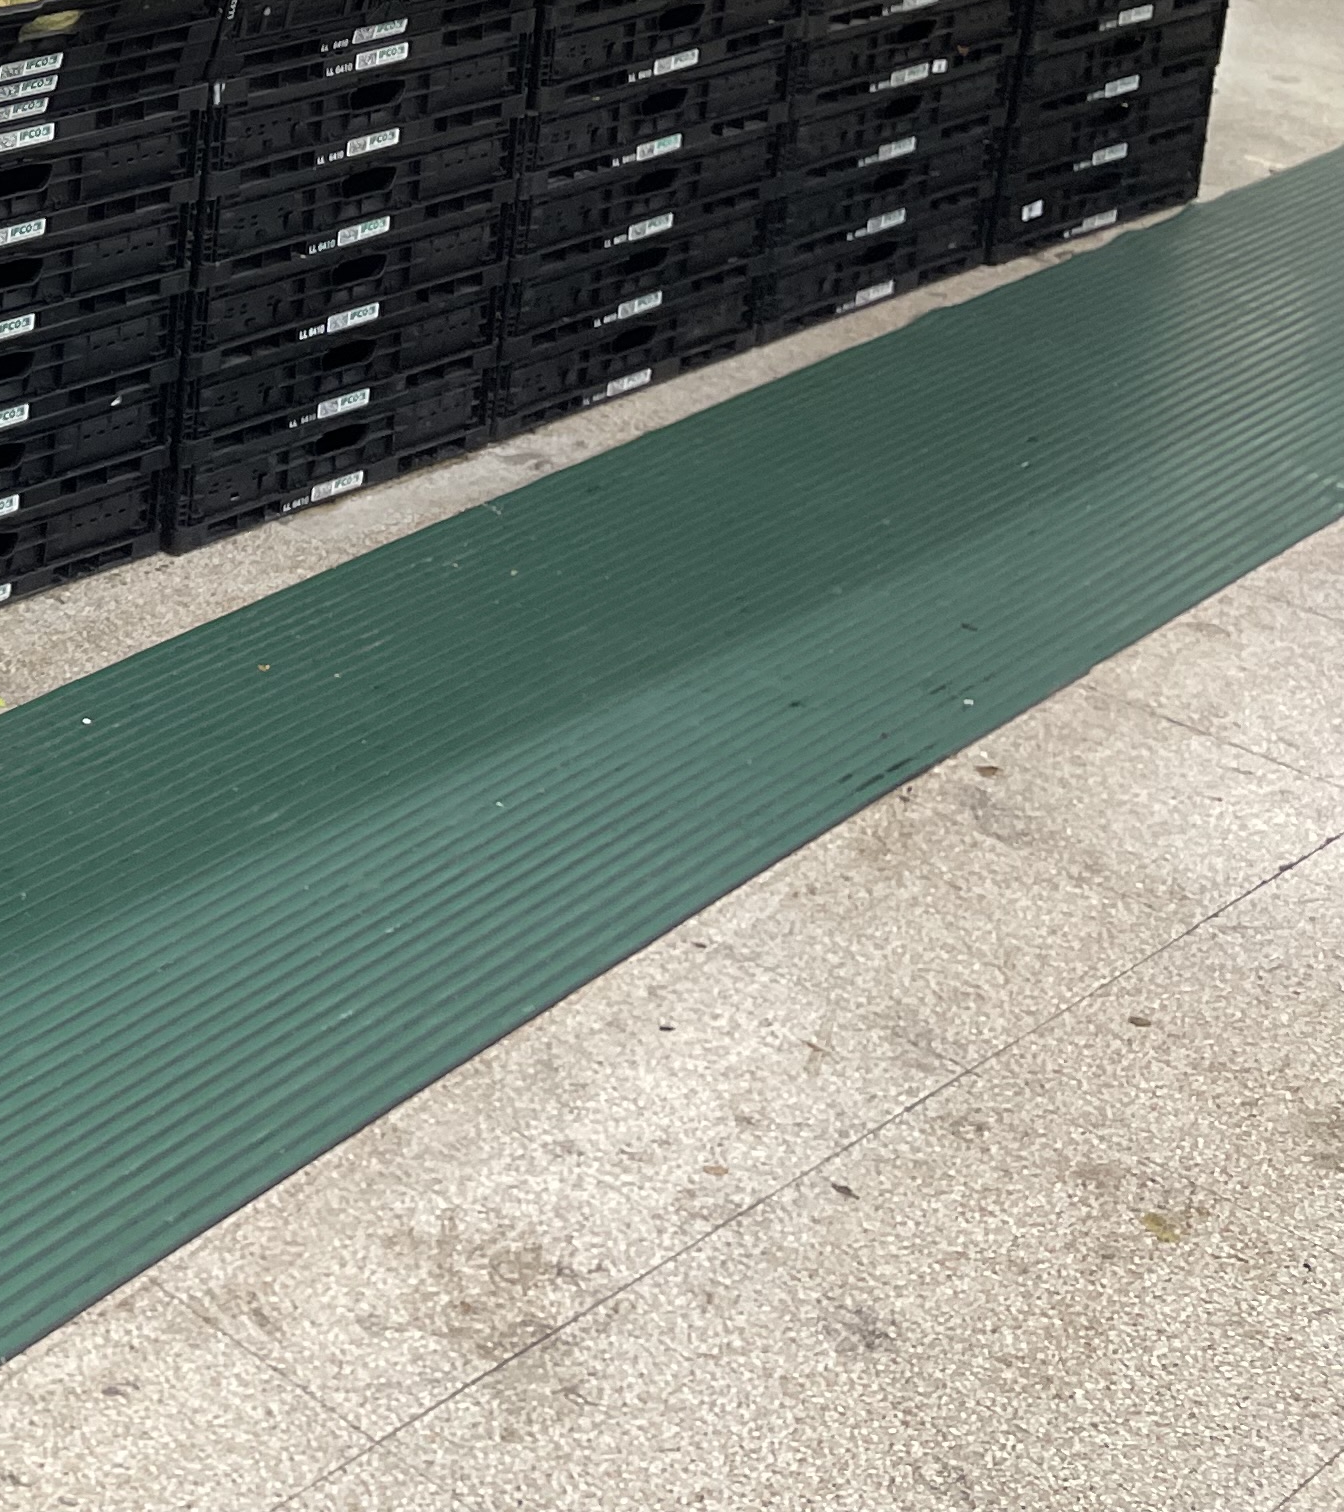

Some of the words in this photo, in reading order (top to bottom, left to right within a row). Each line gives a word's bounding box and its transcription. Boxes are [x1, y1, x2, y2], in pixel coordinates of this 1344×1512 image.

[25, 58, 49, 71] IFCO
[20, 80, 44, 92] IFCO
[11, 101, 34, 113] IFCO
[19, 127, 42, 141] IFCO
[10, 223, 33, 237] IFCO
[0, 320, 22, 333] IFCO
